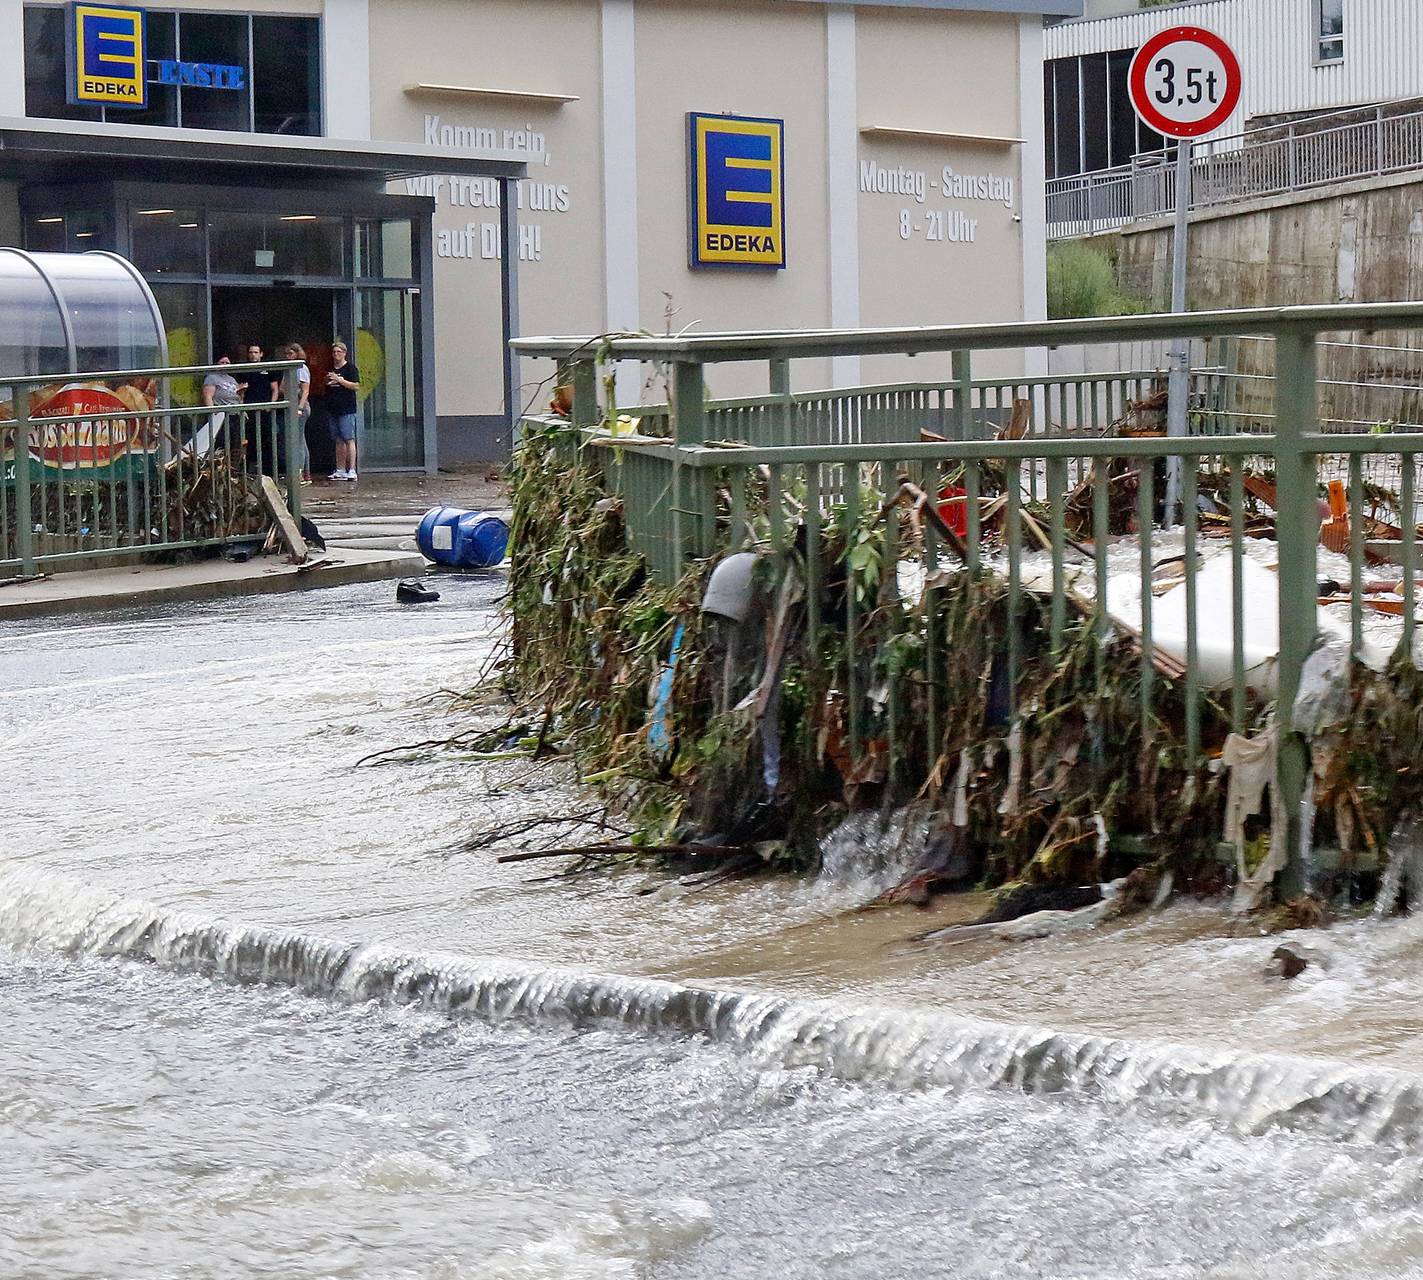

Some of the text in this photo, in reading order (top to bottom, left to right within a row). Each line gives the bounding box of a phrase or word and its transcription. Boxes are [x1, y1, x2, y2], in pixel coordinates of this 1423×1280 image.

[84, 82, 138, 96] EDEKA
[424, 114, 497, 149] Komm
[449, 176, 523, 209] freu
[529, 182, 569, 212] uns
[860, 160, 926, 203] Montag
[942, 166, 1015, 208] Samstag
[437, 222, 542, 261] auf DIH!
[706, 233, 775, 252] EDEKA
[900, 209, 909, 240] 8
[925, 211, 943, 241] 21
[948, 211, 977, 243] Uhr
